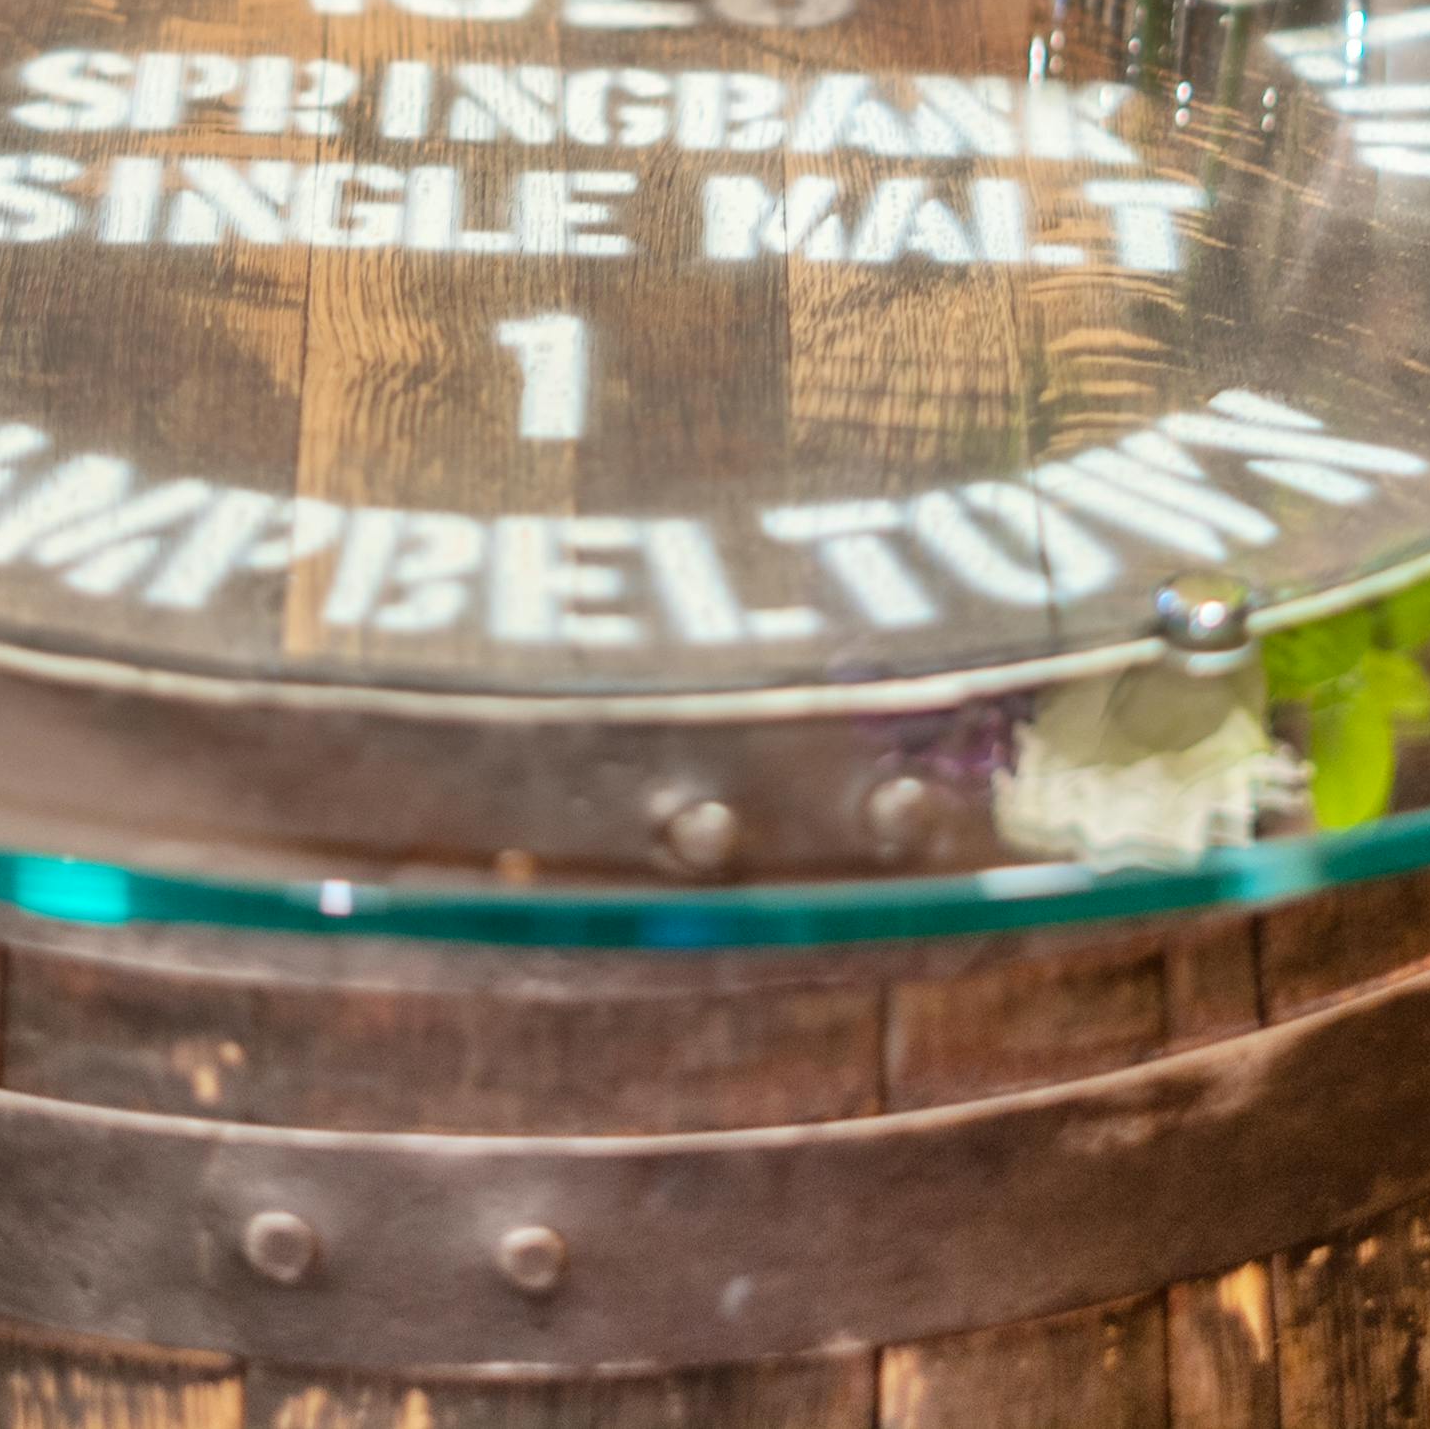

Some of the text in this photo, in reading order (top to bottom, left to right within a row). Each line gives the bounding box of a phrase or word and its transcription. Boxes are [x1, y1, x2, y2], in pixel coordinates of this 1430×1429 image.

[9, 46, 1143, 166] SPRINGBANK
[699, 172, 1209, 275] MALT
[497, 314, 593, 440] 1
